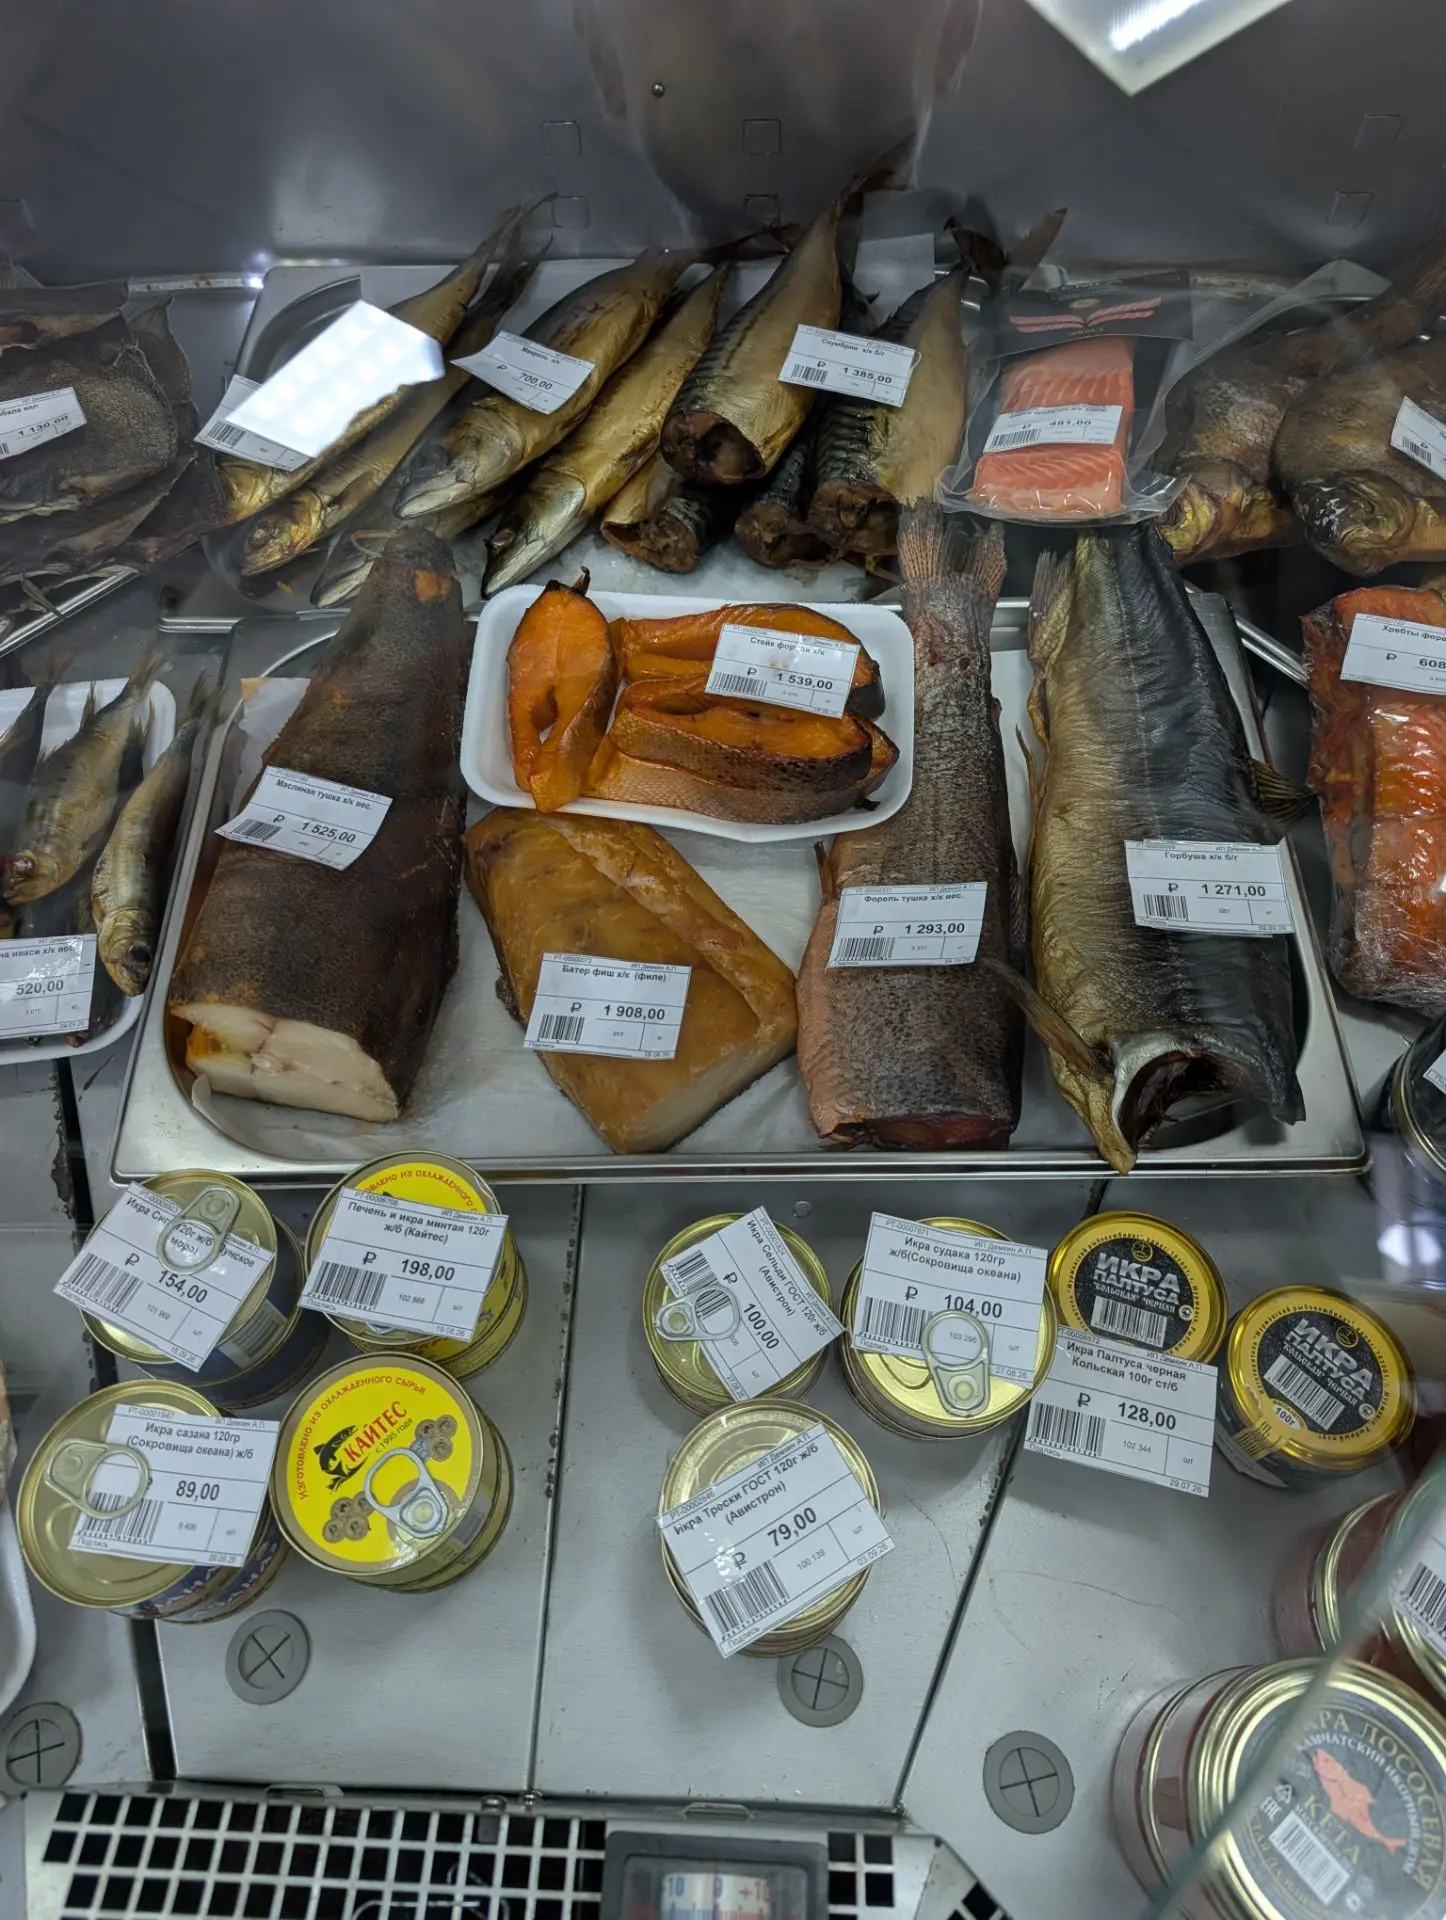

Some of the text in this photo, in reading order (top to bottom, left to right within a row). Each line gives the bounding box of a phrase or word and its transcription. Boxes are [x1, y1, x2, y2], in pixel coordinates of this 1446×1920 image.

[519, 372, 553, 390] 700,00
[852, 369, 892, 383] 385,00
[30, 415, 68, 433] 130,00
[1382, 625, 1419, 636] Хребты
[750, 636, 825, 656] Стейк форли х/к
[775, 672, 783, 681] 1
[788, 674, 833, 690] 539,00
[276, 779, 316, 796] Масляная
[317, 791, 341, 802] тушка
[341, 797, 355, 805] х/к
[300, 821, 310, 831] 1
[311, 824, 356, 843] 525,00
[1163, 851, 1206, 861] Горбуша
[1202, 884, 1208, 894] 1
[1214, 884, 1266, 898] 271,00
[904, 924, 912, 934] 1
[916, 922, 965, 935] 293,00
[12, 947, 40, 957] иваси
[562, 964, 590, 975] Батер
[592, 968, 614, 977] фиш
[634, 972, 667, 983] (филе)
[16, 980, 64, 996] 520,00
[603, 1004, 611, 1015] 1
[616, 1006, 665, 1020] 908,00
[365, 1174, 398, 1193] ОВЛЕНО
[416, 1170, 473, 1206] ОХЛАЖДЕННОГО
[126, 1197, 151, 1215] Икра
[151, 1210, 171, 1226] Сиг
[195, 1234, 215, 1246] ж/б
[348, 1201, 387, 1217] Печень
[399, 1214, 424, 1225] икра
[426, 1219, 464, 1232] минтая
[468, 1223, 490, 1236] 120г
[384, 1224, 448, 1245] ж/б (Кайтес)
[905, 1236, 1005, 1267] Икра судака 120гр
[402, 1259, 455, 1281] 198,00
[747, 1220, 828, 1336] Икра Сельди ГОСТ 120г ж/б
[889, 1248, 1021, 1284] ж/б(Сокровища океана)
[1096, 1252, 1181, 1293] ИКРА
[158, 1270, 208, 1303] 154,00
[758, 1265, 796, 1316] (Авистрон)
[1093, 1269, 1180, 1305] ПАЛТУСА
[944, 1294, 1002, 1318] 104,00
[744, 1303, 779, 1349] 100,00
[1067, 1341, 1186, 1380] Икра Палтуса черная
[1285, 1331, 1366, 1400] ПАЛТУСА
[1294, 1318, 1373, 1391] ИКРА
[1072, 1356, 1178, 1392] Кольская 100г ст/б
[1118, 1402, 1176, 1430] 128,00
[1275, 1407, 1295, 1426] 100г
[145, 1422, 240, 1444] Икра сазана 120гр
[296, 1375, 427, 1500] ИЗГОТОВЛЕНО ИЗ ОХЛАЖДЕННОГО СЫРЬЯ
[344, 1401, 408, 1463] КАЙТЕС
[125, 1435, 254, 1459] (Сокровища океана) ж/б
[176, 1480, 220, 1501] 89,00
[673, 1443, 818, 1535] Икра Трески ГОСТ 120г ж/б
[725, 1480, 786, 1525] (Авистрон)
[767, 1507, 816, 1546] 79,00
[1360, 1723, 1443, 1890] ЛОСОСЕВАЯ
